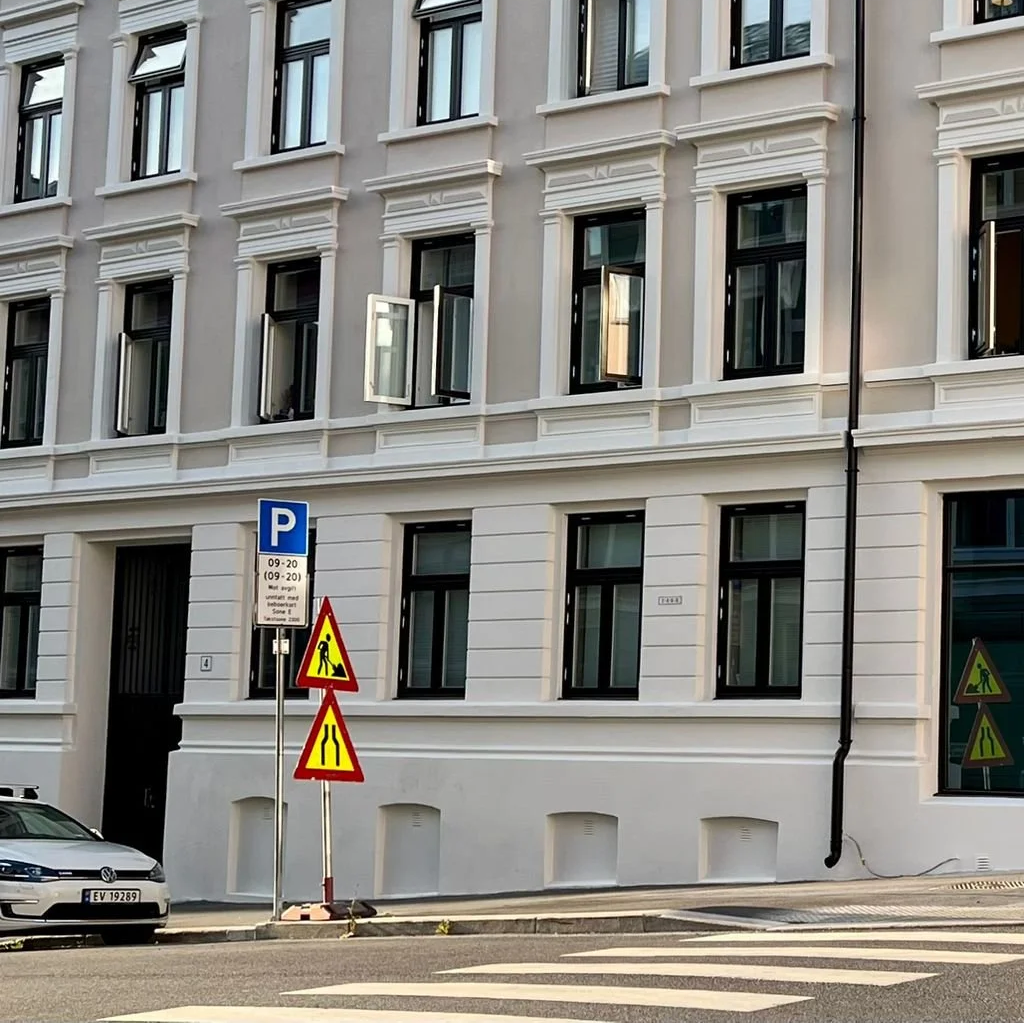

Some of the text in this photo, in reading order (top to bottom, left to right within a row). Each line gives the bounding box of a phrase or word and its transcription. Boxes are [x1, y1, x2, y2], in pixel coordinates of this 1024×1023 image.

[271, 507, 296, 547] P
[268, 558, 298, 568] 09-20
[264, 571, 302, 582] (09-20)
[93, 891, 137, 902] EV 19289
